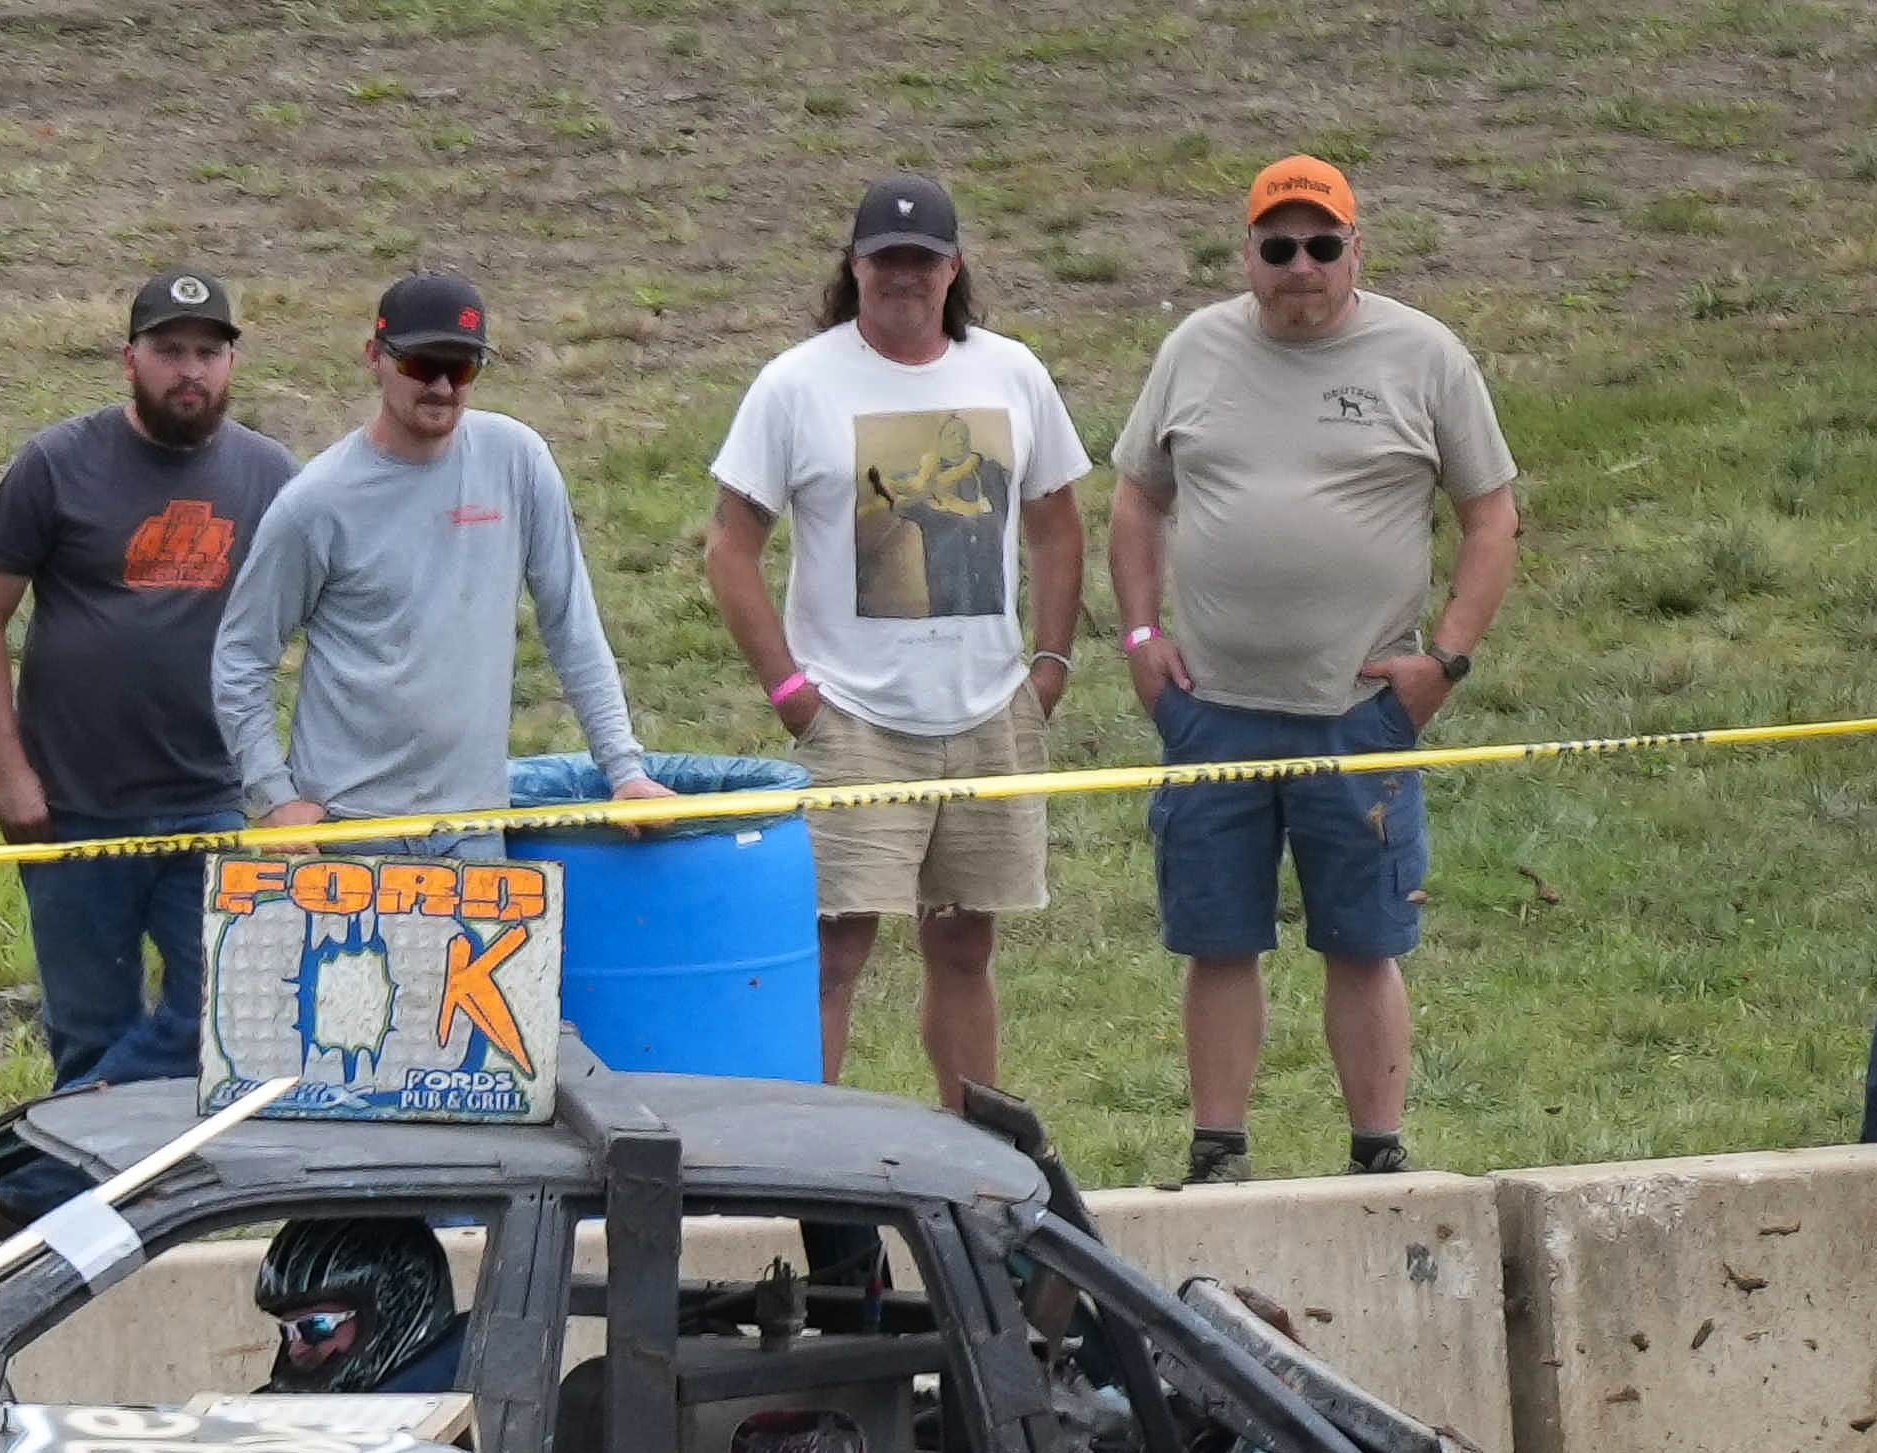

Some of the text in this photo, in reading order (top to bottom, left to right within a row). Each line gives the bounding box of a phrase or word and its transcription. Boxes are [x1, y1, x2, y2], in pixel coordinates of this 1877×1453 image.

[216, 860, 546, 920] FORD
[400, 1089, 442, 1111] PUB
[446, 1090, 463, 1110] &
